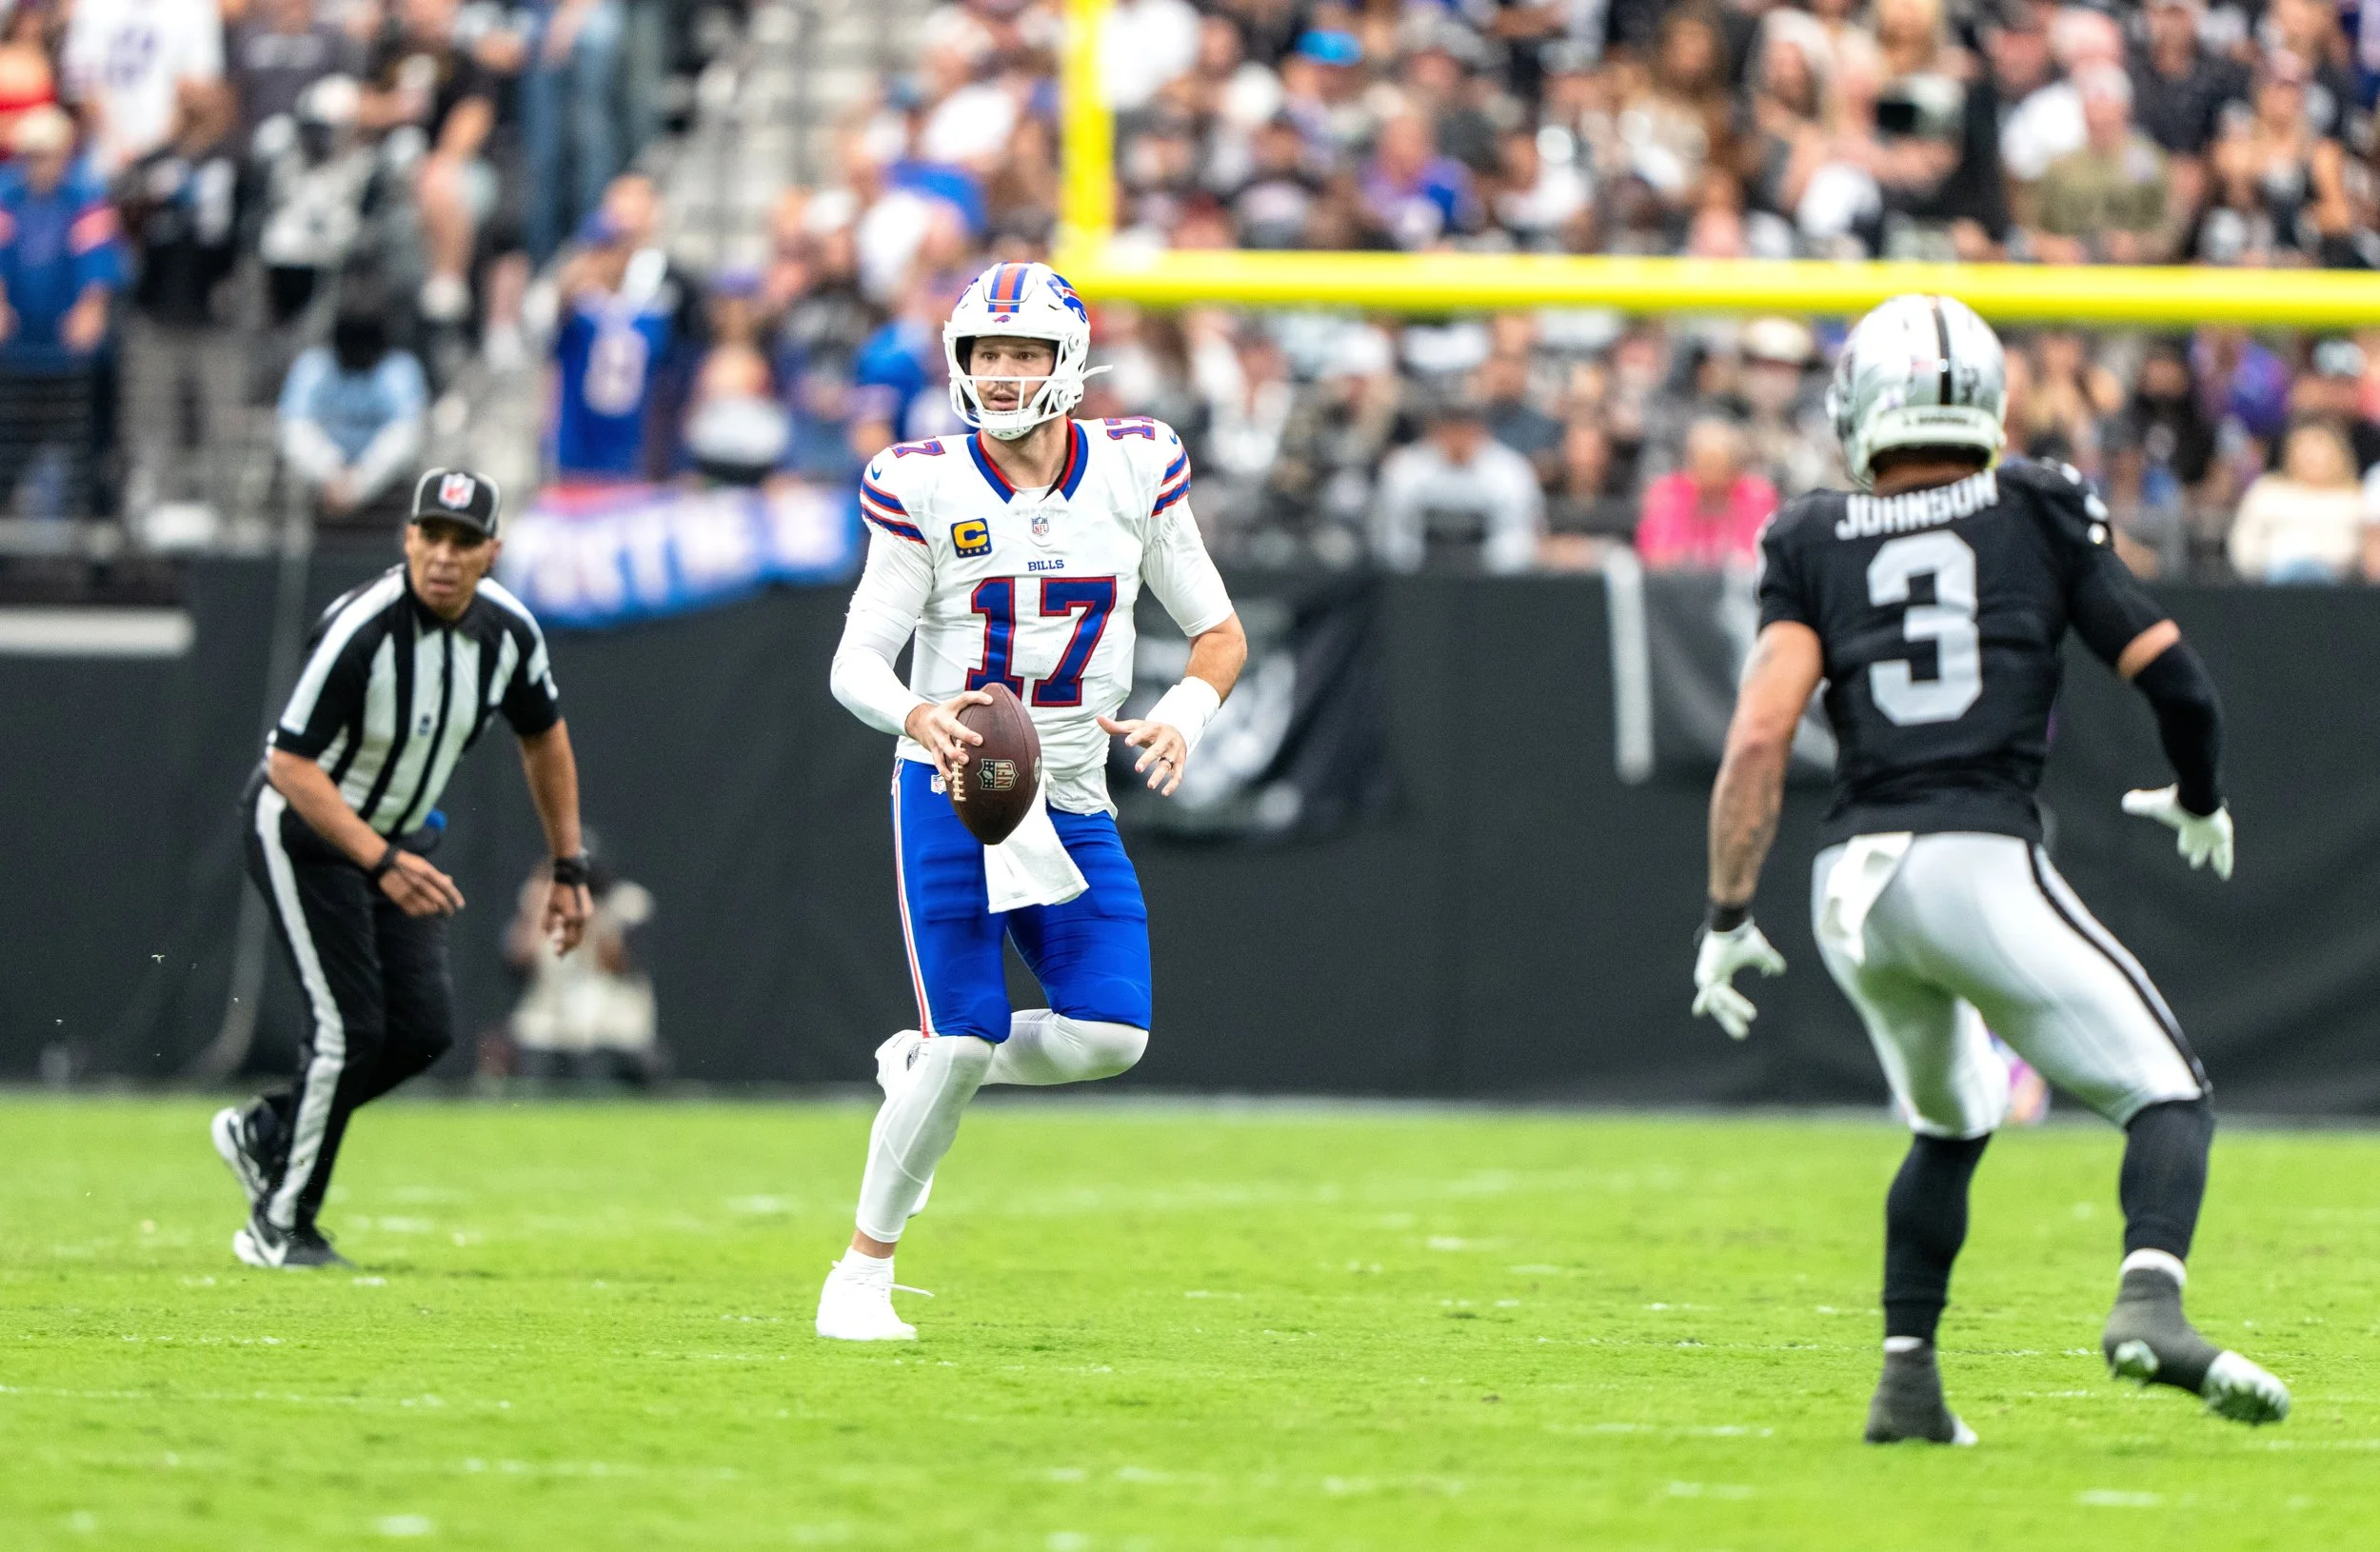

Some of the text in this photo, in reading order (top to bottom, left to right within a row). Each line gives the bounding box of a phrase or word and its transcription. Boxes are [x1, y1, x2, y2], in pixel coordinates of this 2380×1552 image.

[1835, 468, 1997, 540] JOHNSON
[954, 521, 987, 548] C
[1027, 559, 1064, 571] BILLS
[965, 576, 1117, 706] 17
[1868, 529, 1981, 726] 3
[996, 763, 1013, 787] NFL
